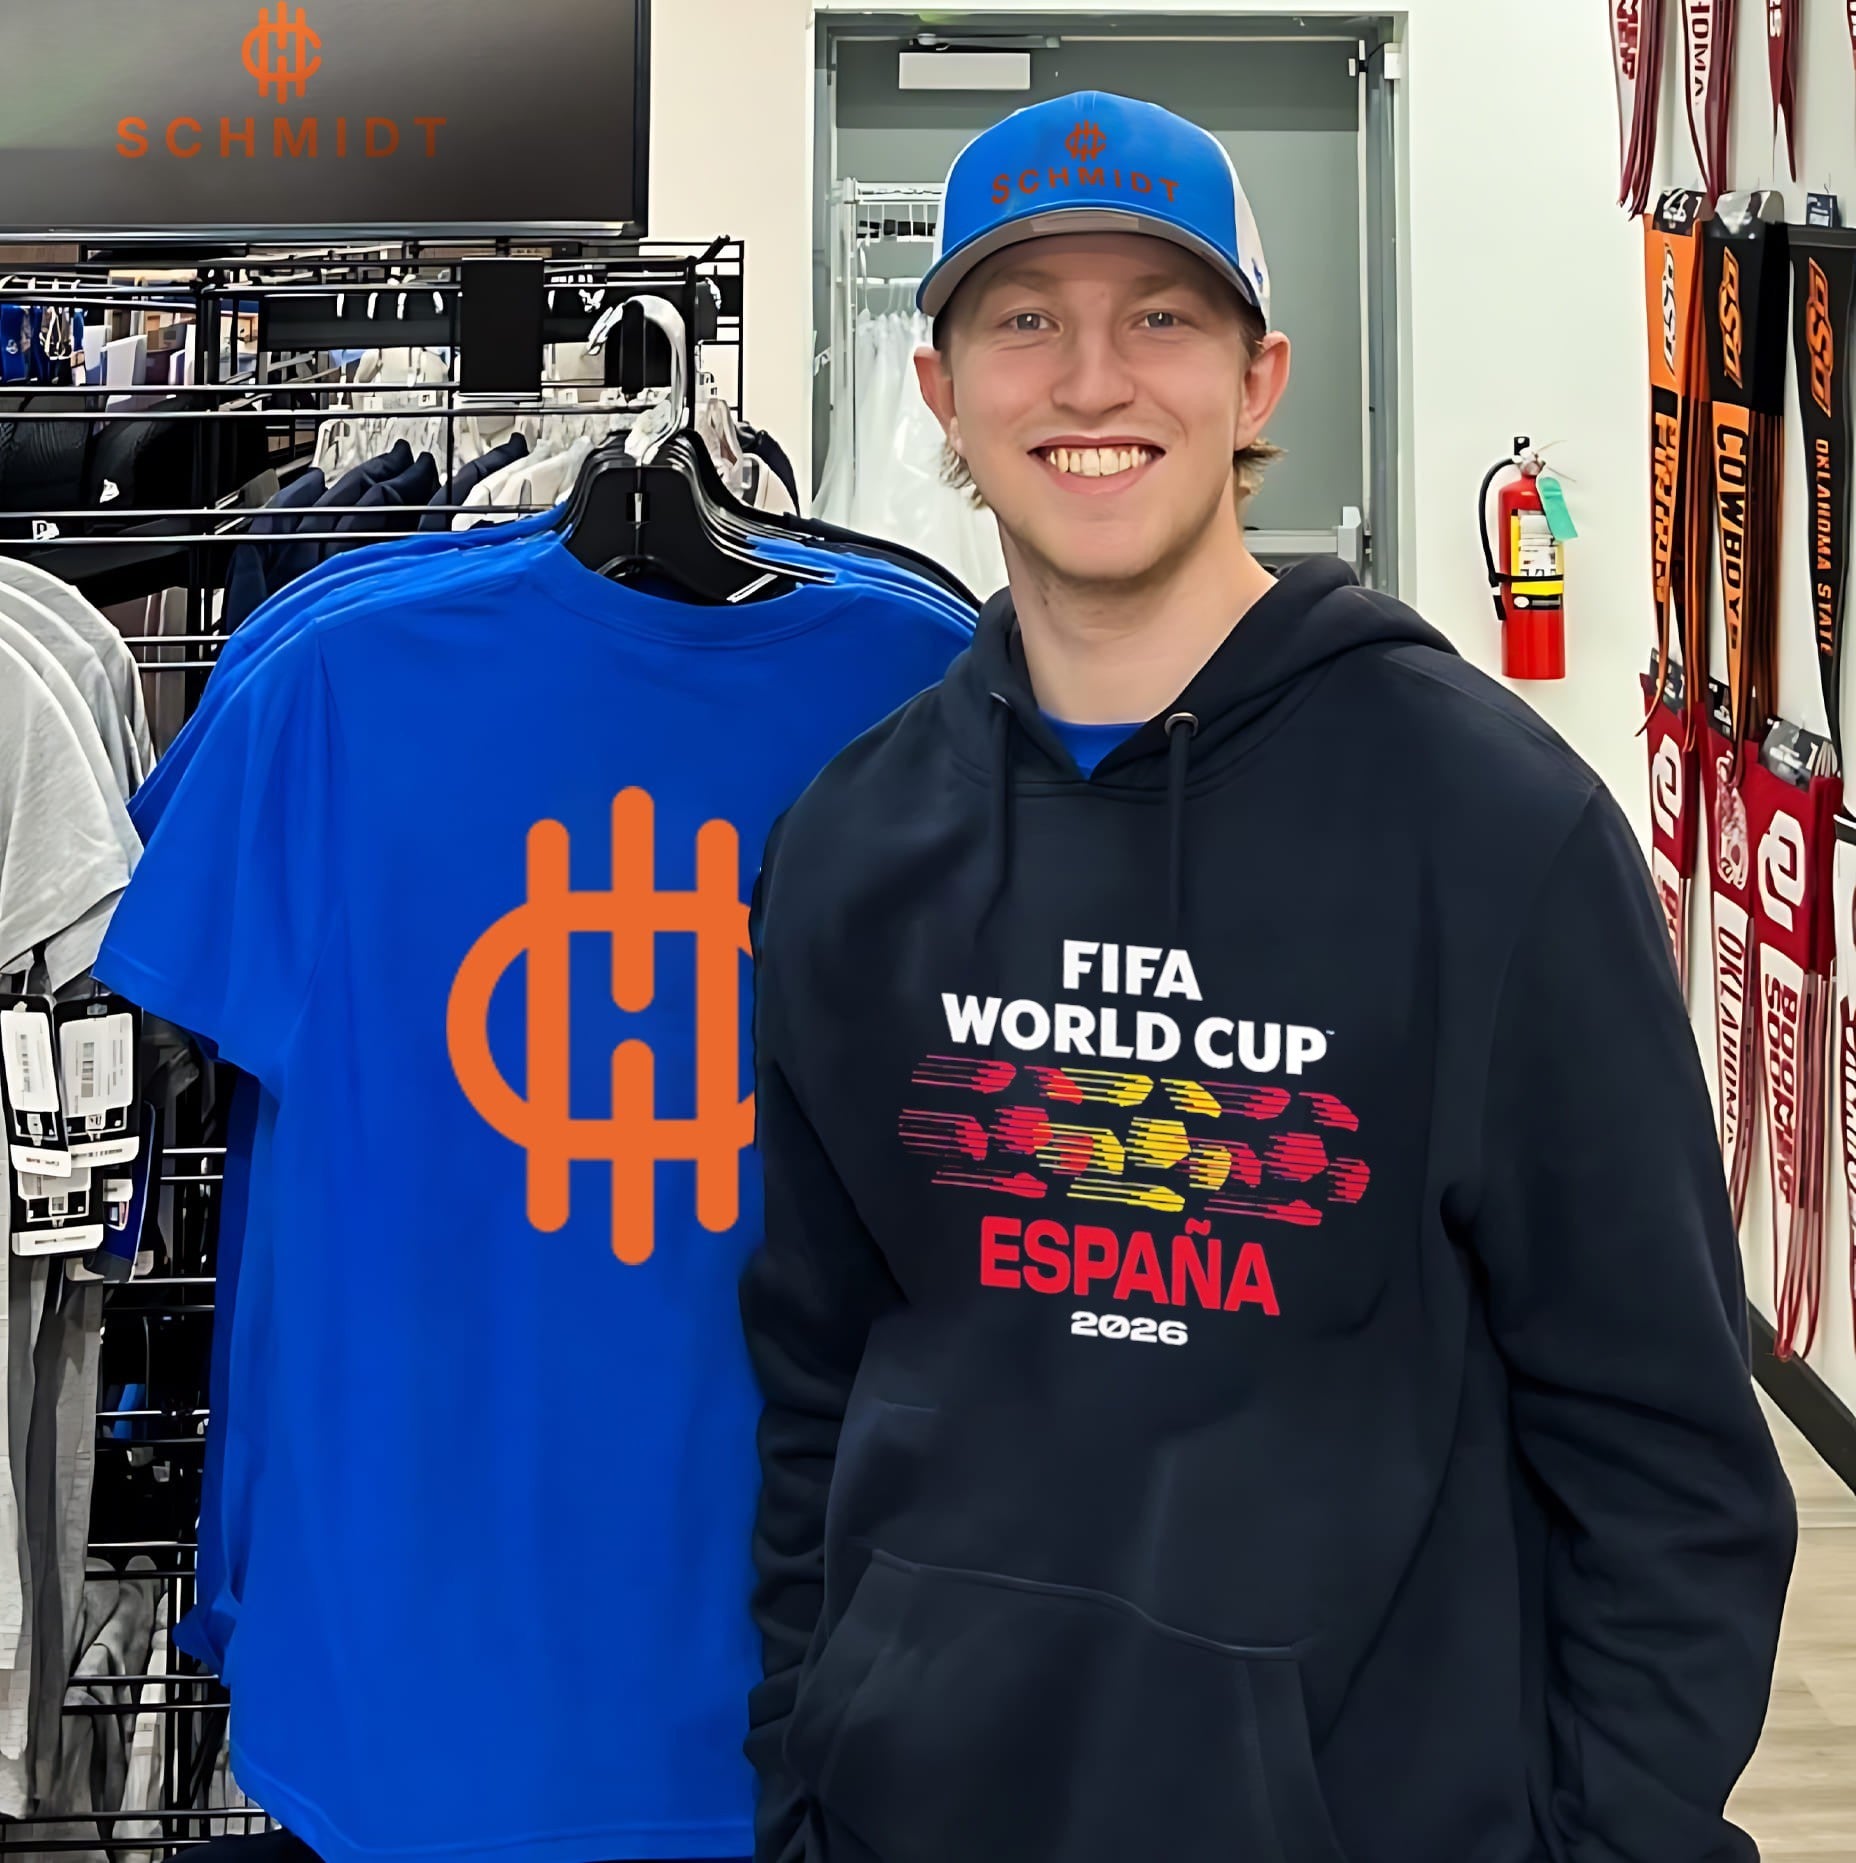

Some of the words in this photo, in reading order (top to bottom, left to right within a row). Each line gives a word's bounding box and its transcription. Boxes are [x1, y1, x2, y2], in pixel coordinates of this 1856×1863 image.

[116, 116, 448, 159] SCHMIDT
[991, 166, 1180, 205] SCHMIDT
[1063, 939, 1203, 1001] FIFA
[941, 992, 1181, 1062] WORLD
[1194, 1016, 1327, 1075] CUP
[980, 1216, 1281, 1317] ESPAÑA
[1070, 1310, 1188, 1346] 2026
